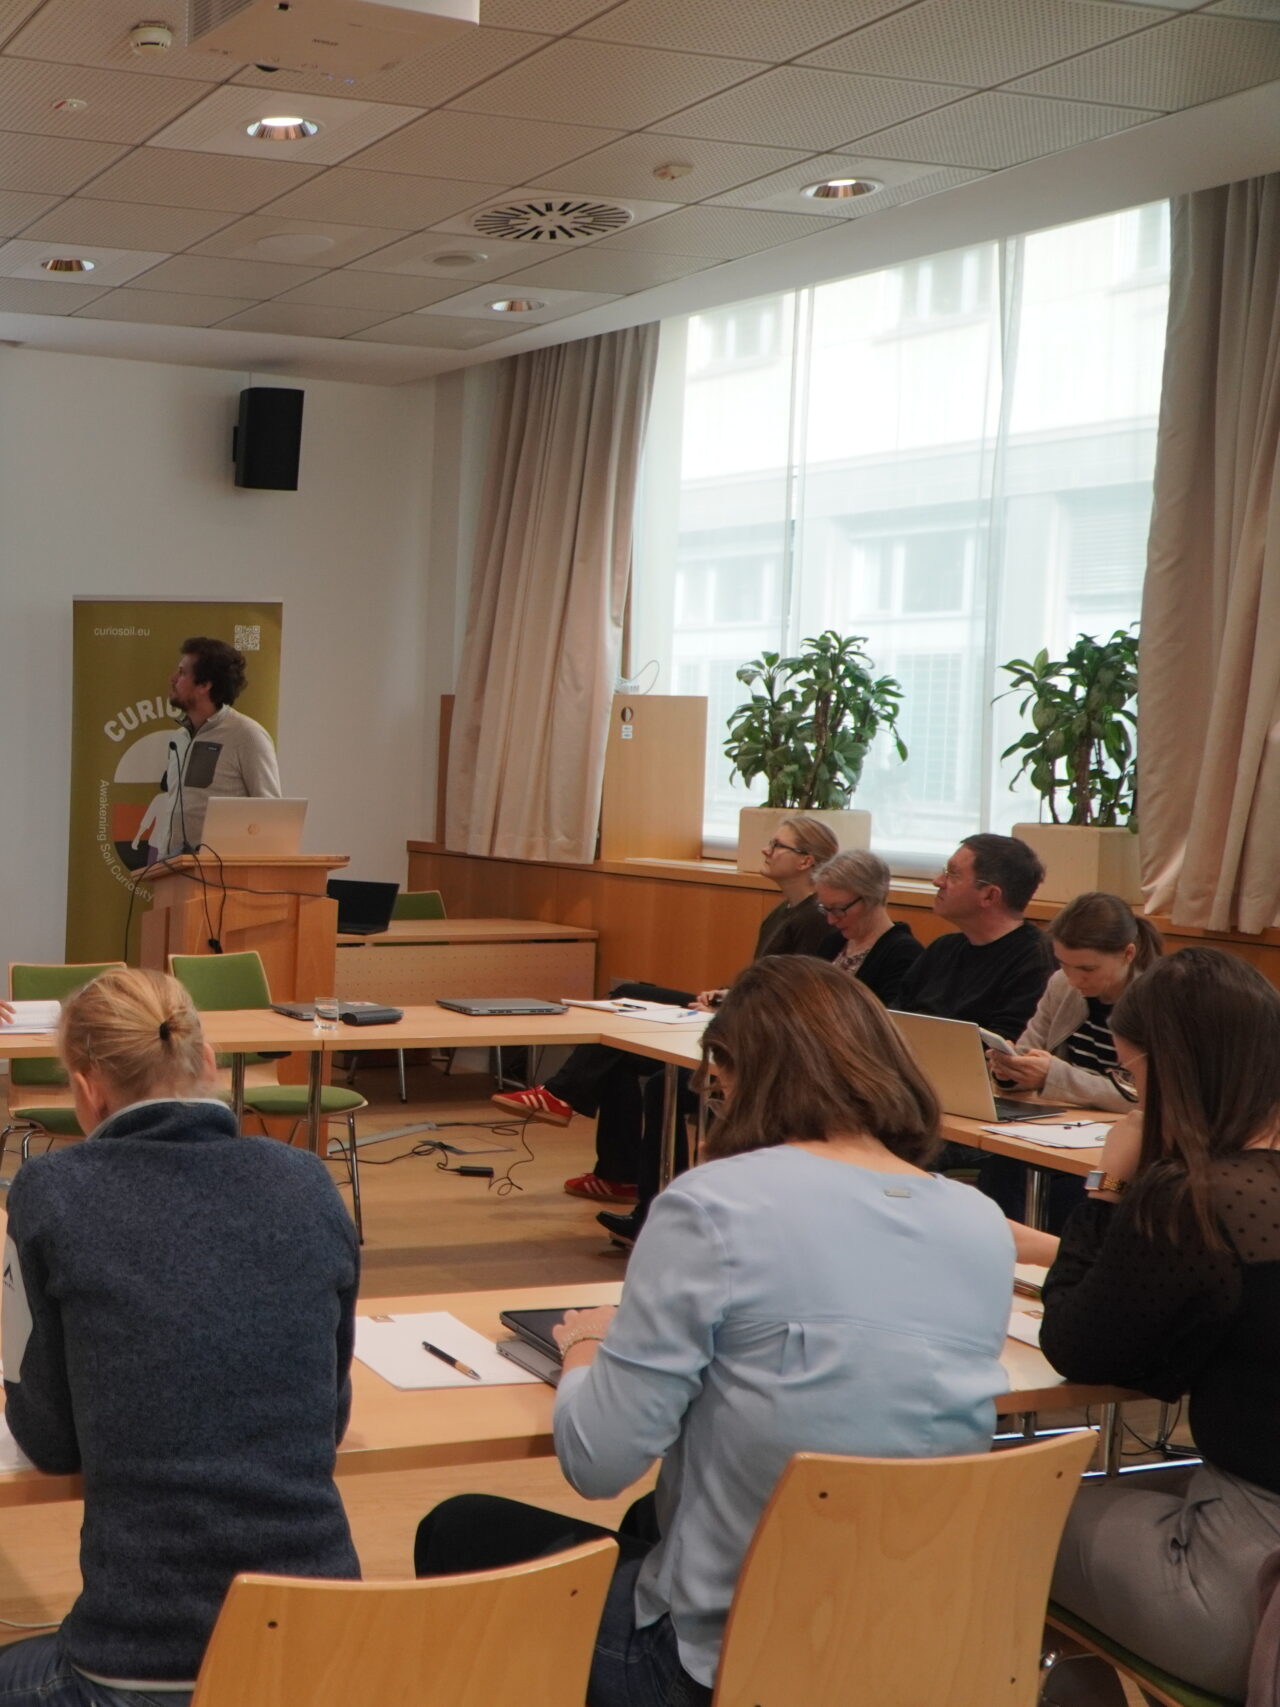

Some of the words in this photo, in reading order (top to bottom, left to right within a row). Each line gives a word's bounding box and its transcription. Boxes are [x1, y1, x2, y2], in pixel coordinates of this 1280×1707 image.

[94, 626, 150, 637] curiosoil.eu
[103, 696, 182, 742] CURIO
[97, 779, 110, 841] Awakening
[100, 843, 112, 865] Soil
[111, 864, 154, 902] Curiosity
